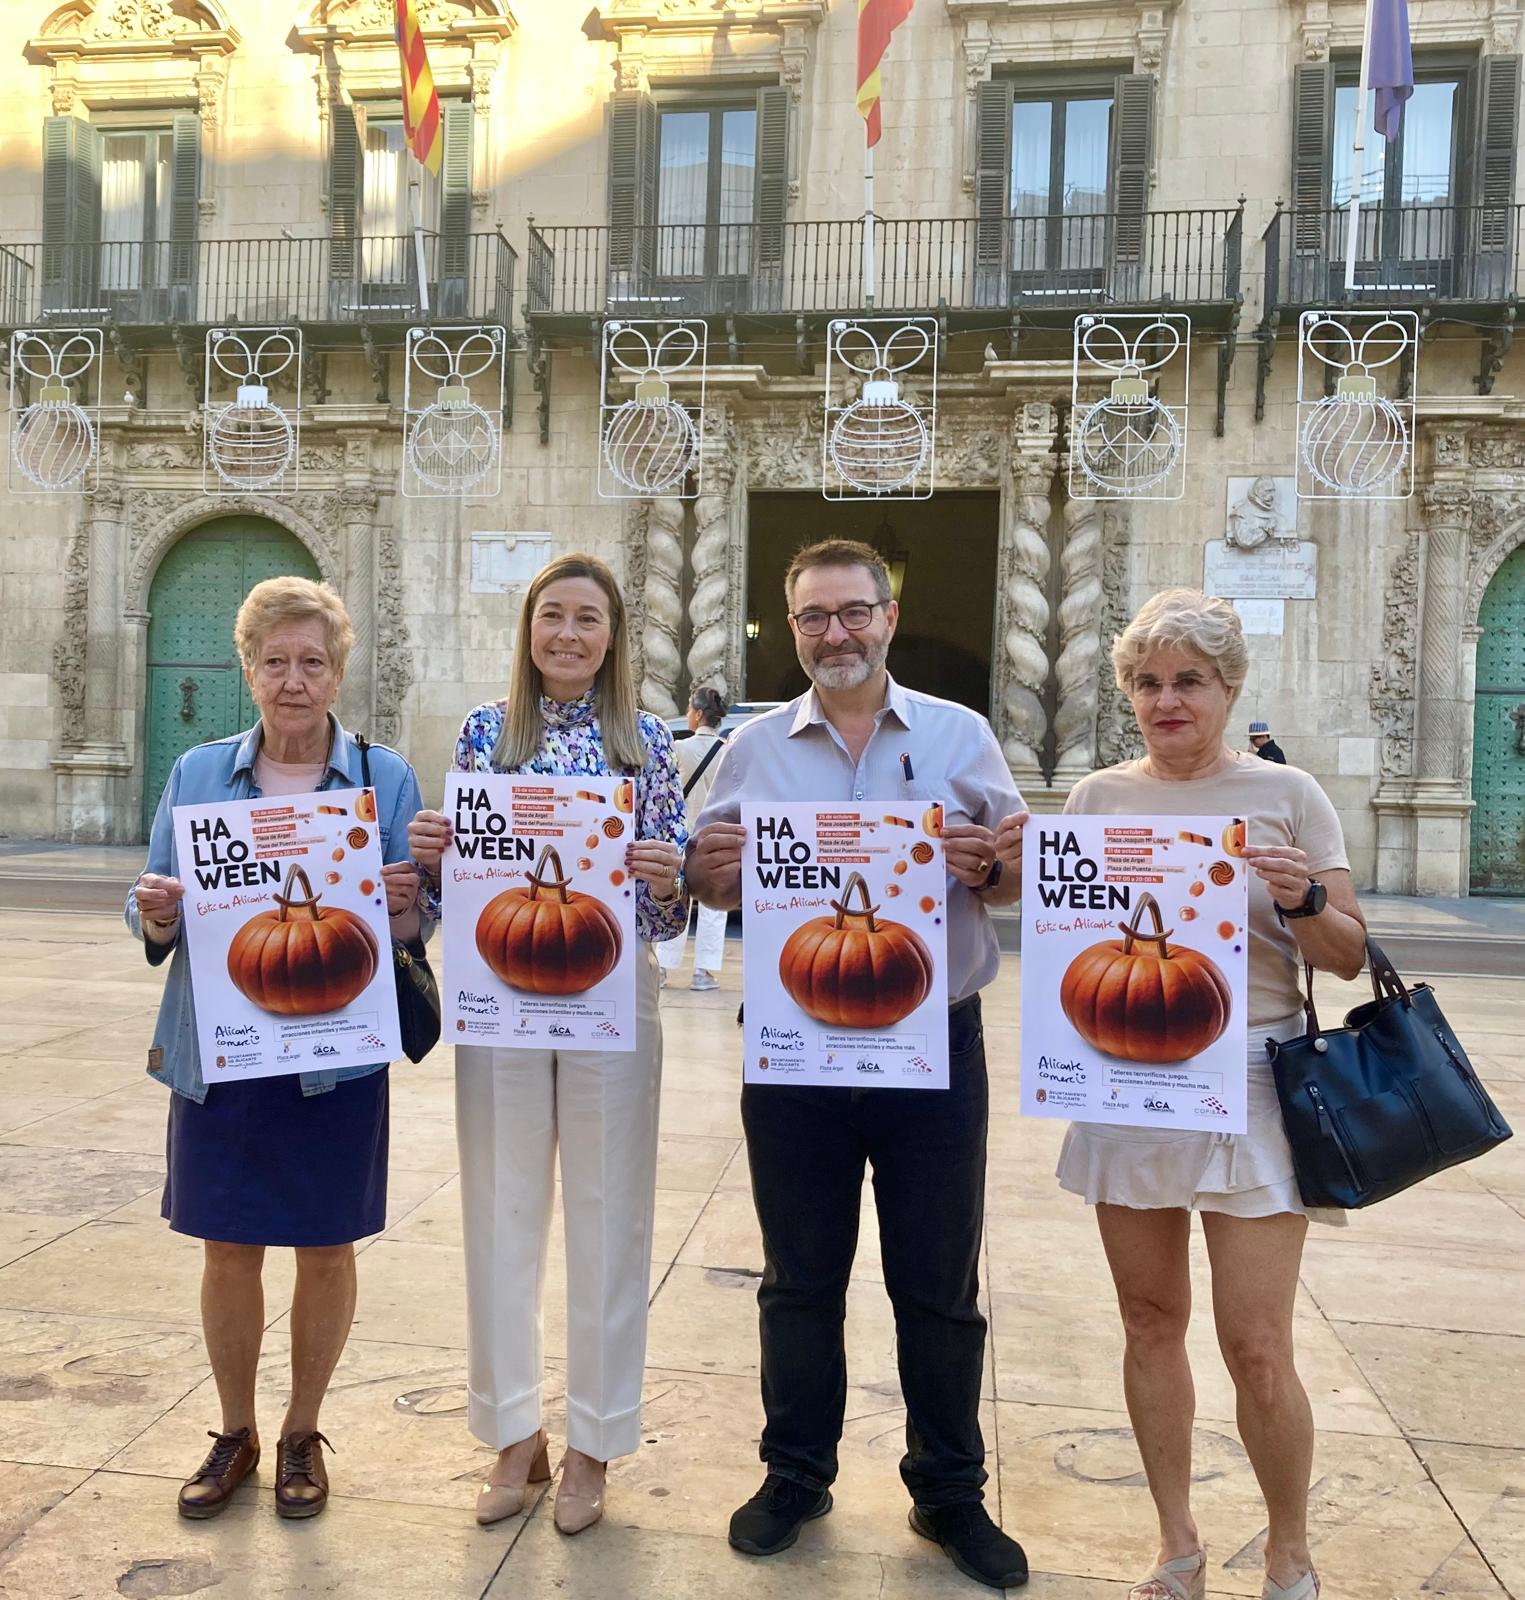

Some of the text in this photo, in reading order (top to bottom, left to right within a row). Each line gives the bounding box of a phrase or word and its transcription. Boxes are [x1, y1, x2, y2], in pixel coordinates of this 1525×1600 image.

[454, 788, 491, 811] HA
[190, 815, 231, 843] HA
[455, 811, 506, 835] LLO
[756, 816, 795, 840] HA
[193, 838, 249, 867] LLO
[454, 835, 534, 861] WEEN
[757, 840, 810, 864] LLO
[1039, 831, 1081, 856] HA
[194, 858, 281, 892] WEEN
[486, 867, 522, 879] Alicante
[755, 864, 840, 889] WEEN
[1039, 856, 1097, 882] LLO
[231, 891, 270, 907] Alicante
[789, 896, 827, 908] Alicante
[1037, 882, 1129, 910] WEEN
[1073, 917, 1115, 931] Alicante
[457, 990, 497, 1004] Alicante
[458, 1003, 499, 1014] comercio
[213, 1021, 257, 1039] Alicante
[759, 1025, 802, 1040] Alicante
[216, 1034, 260, 1049] comercio
[761, 1039, 804, 1050] comercio
[1038, 1055, 1084, 1072] Alicante
[1109, 1068, 1132, 1076] Talleres
[1039, 1070, 1086, 1084] comercio
